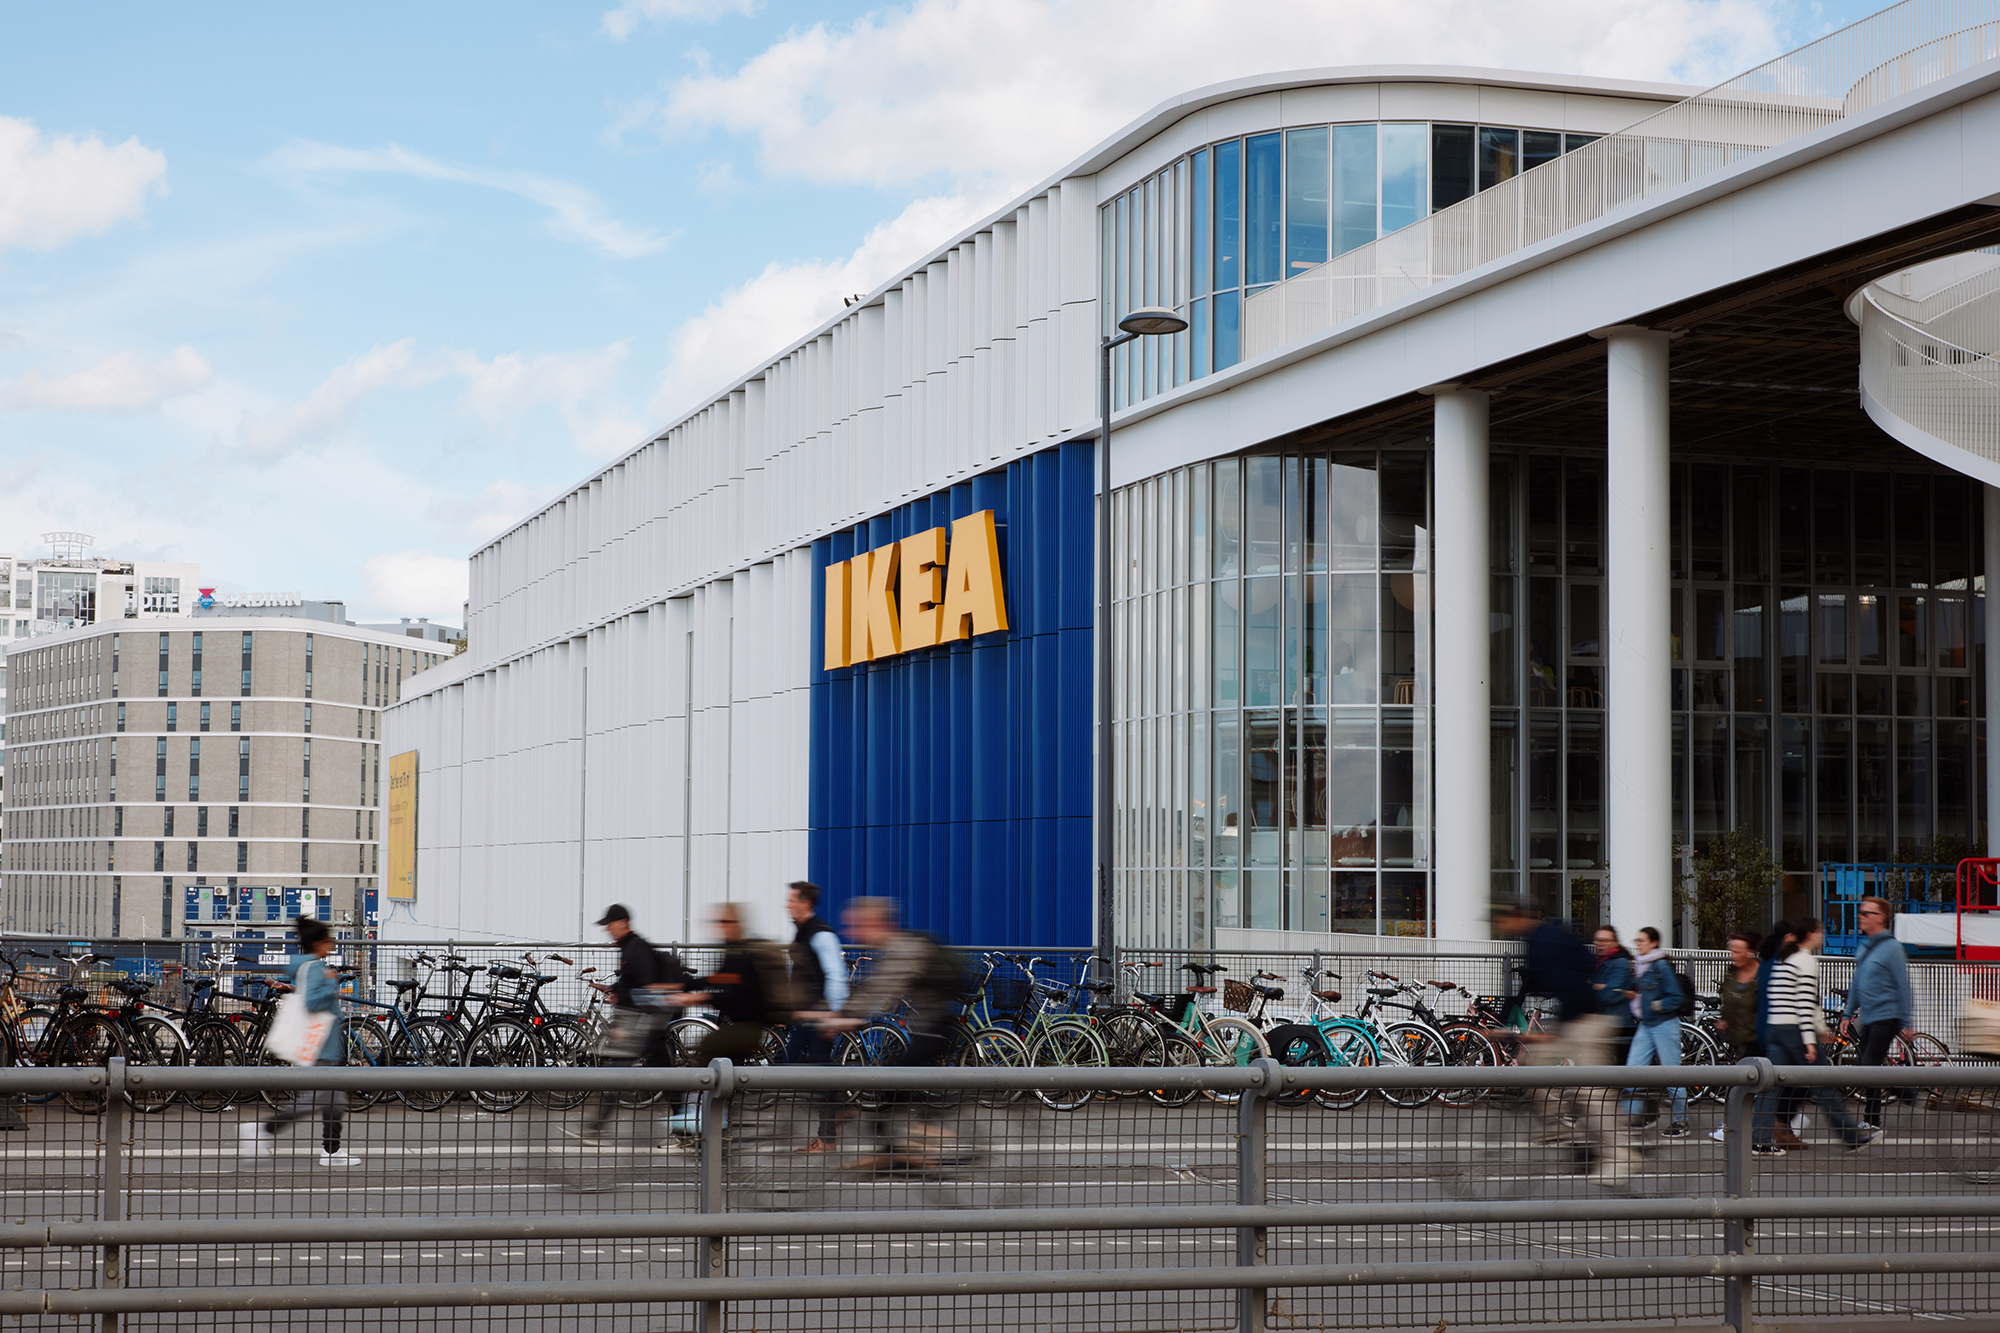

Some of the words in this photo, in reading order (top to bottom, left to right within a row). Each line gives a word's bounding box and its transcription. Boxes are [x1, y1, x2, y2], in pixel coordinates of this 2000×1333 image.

[41, 531, 96, 547] TIVOLI
[824, 509, 1009, 671] IKEA
[223, 591, 302, 608] CABINN
